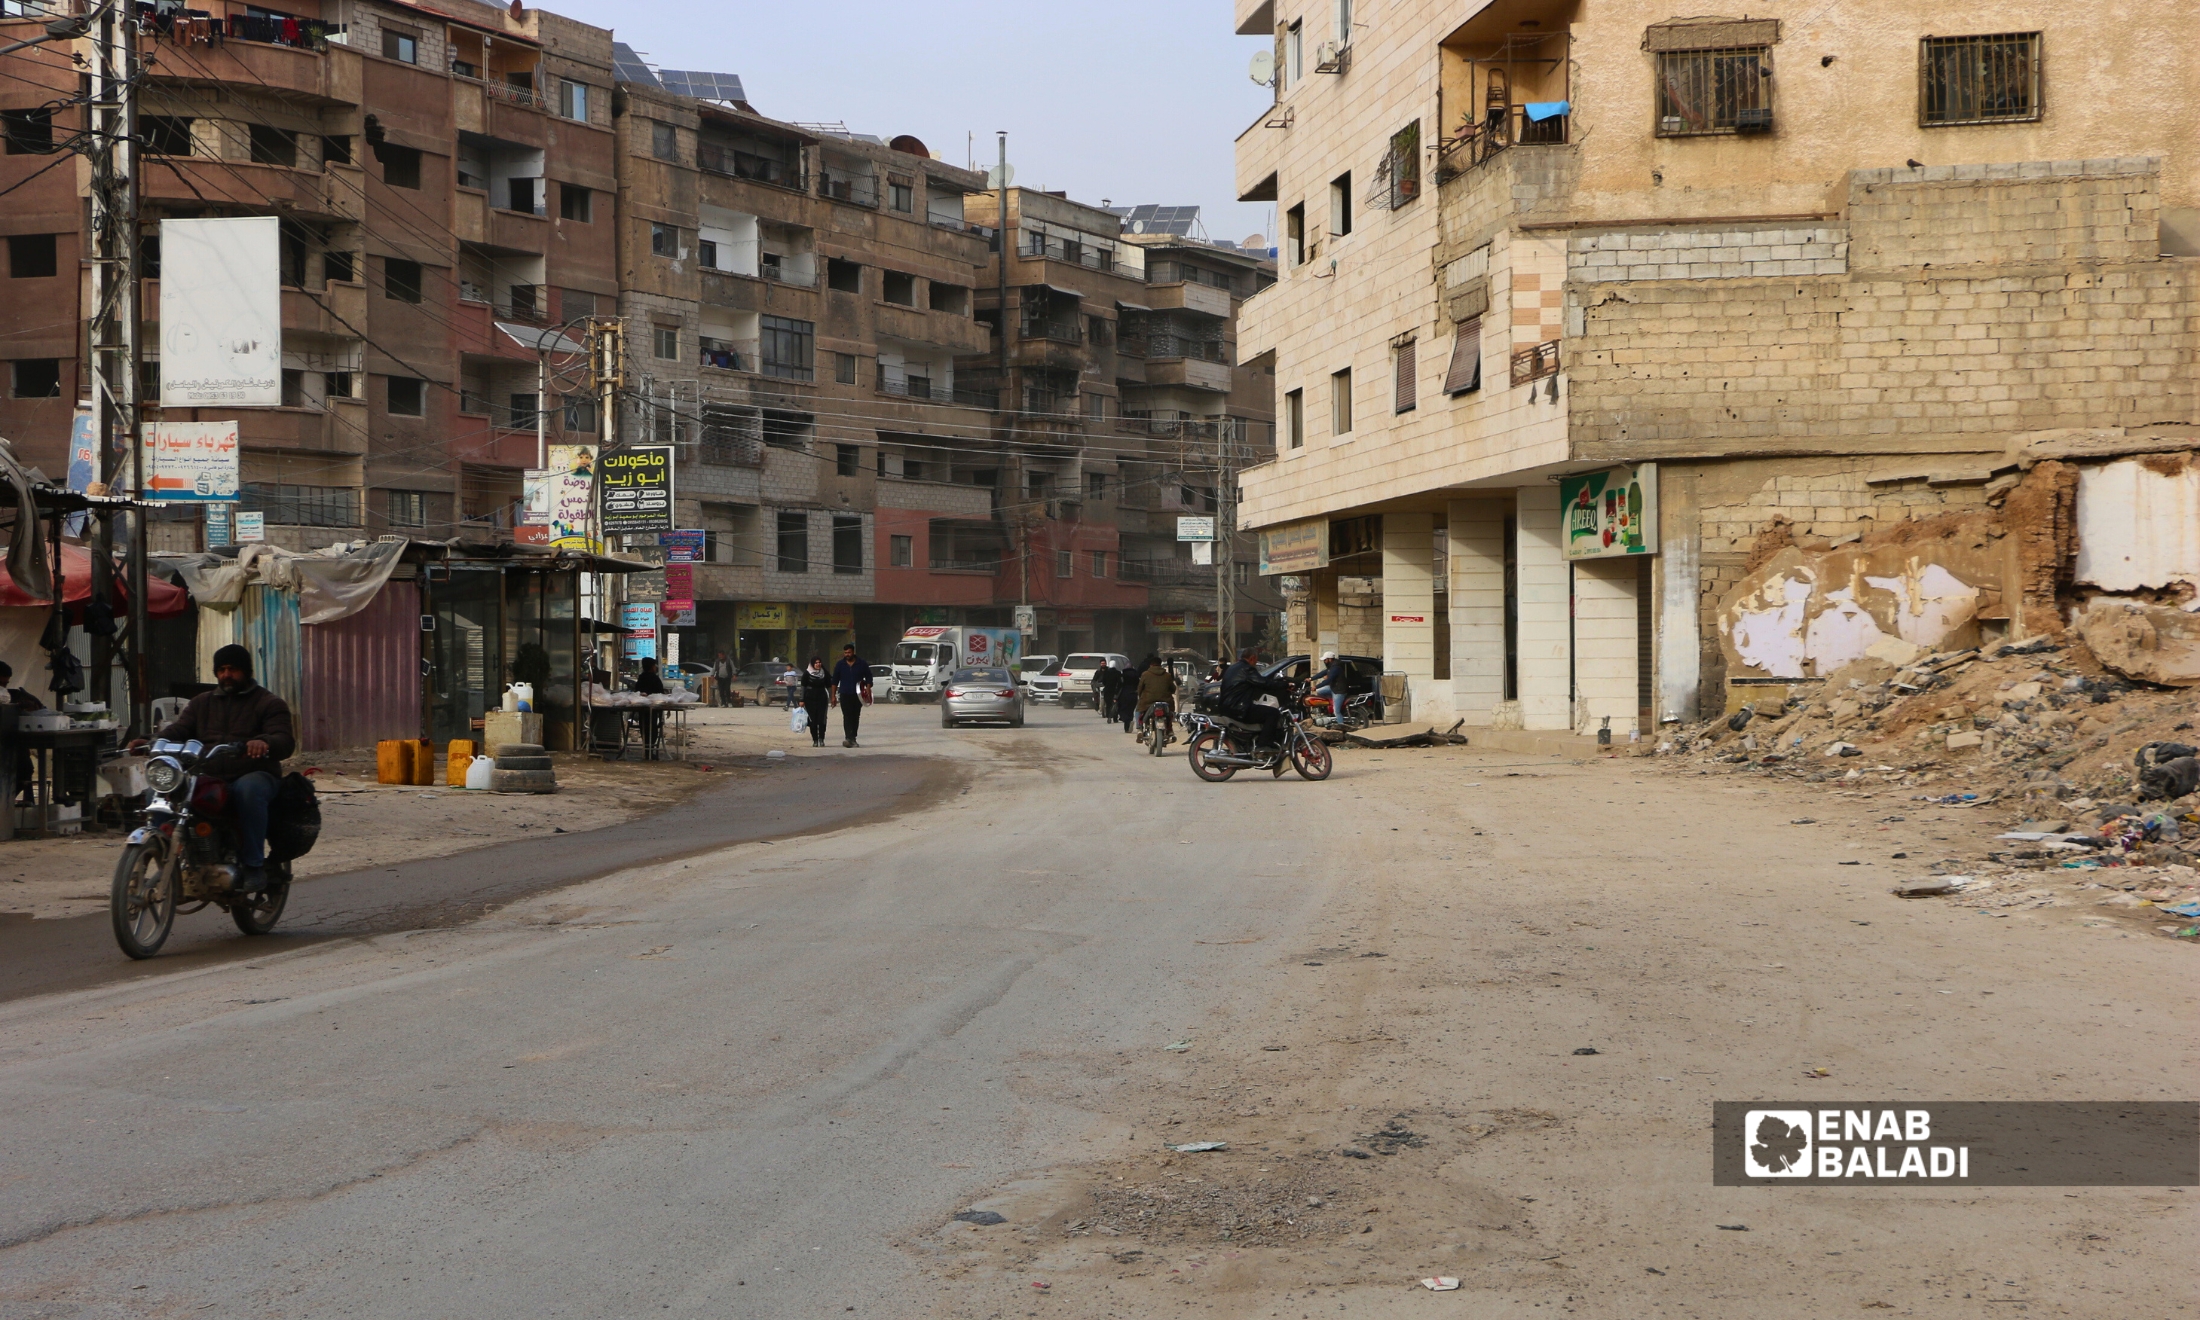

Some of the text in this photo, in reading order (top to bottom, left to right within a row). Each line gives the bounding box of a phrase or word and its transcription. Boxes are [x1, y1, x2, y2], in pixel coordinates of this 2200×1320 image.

[145, 432, 236, 453] كهرباء سيارات
[604, 451, 665, 470] مأكولات
[563, 476, 592, 490] روضة
[604, 468, 665, 487] أبو زيد
[1571, 509, 1597, 531] AREEQ
